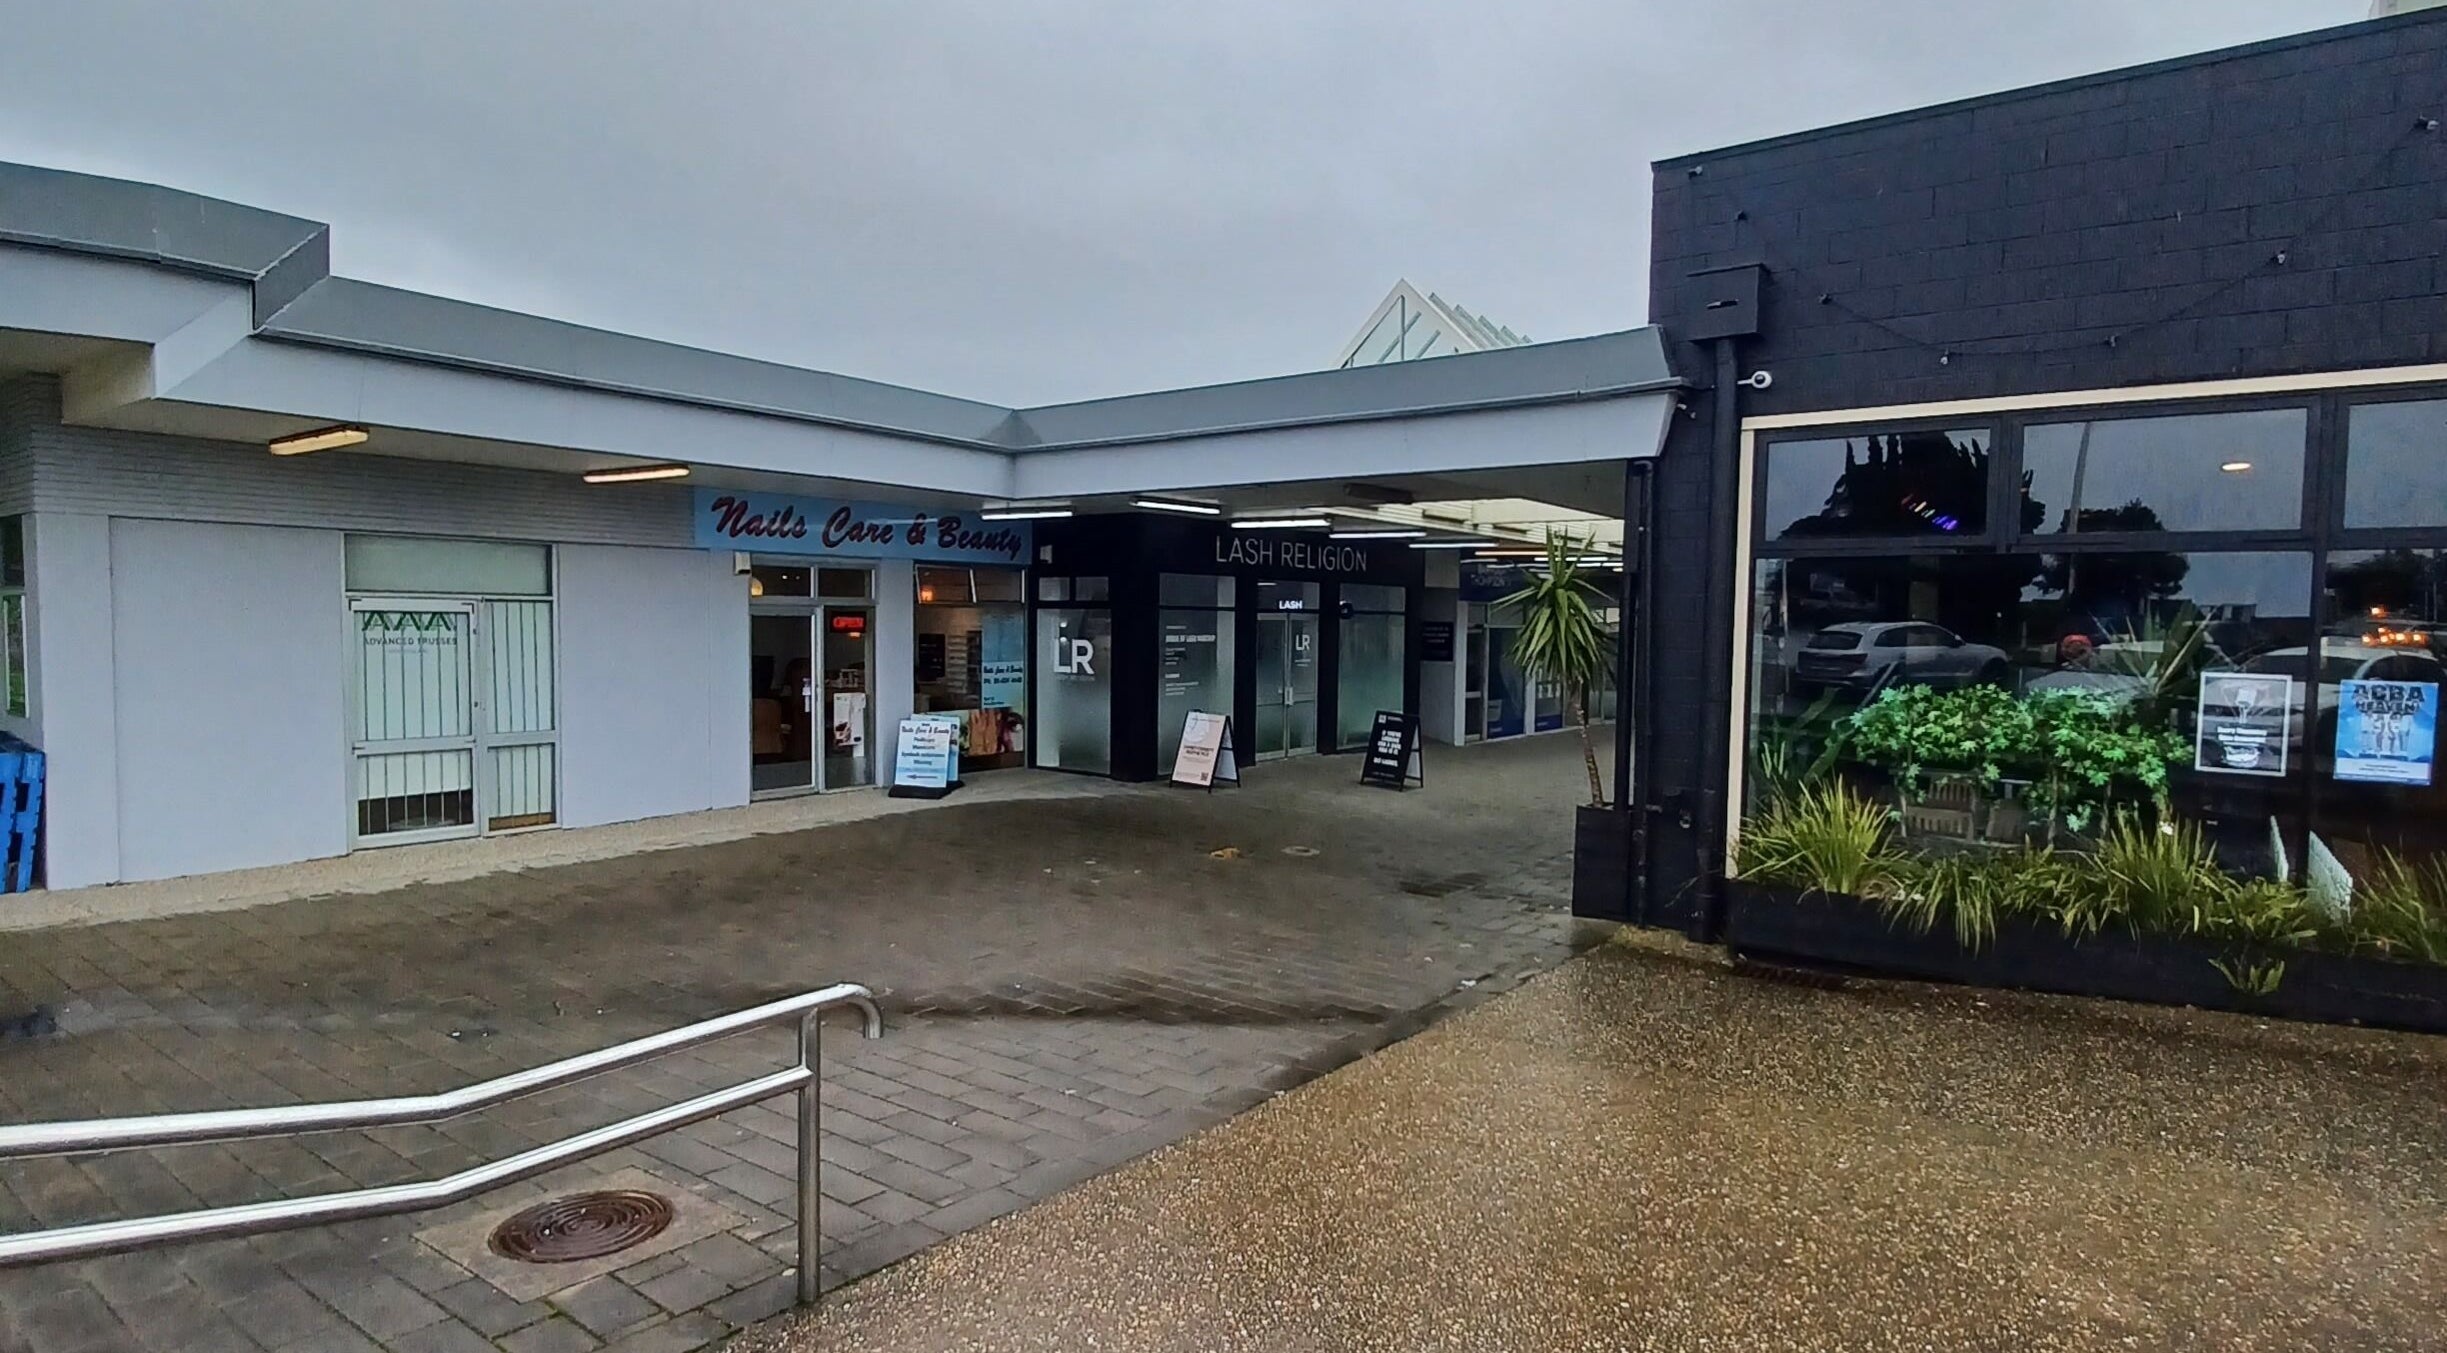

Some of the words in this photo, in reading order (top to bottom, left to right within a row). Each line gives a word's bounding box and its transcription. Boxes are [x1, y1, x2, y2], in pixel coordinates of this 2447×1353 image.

[711, 496, 807, 538] Nails
[822, 506, 893, 548] Care
[906, 512, 926, 545] &
[936, 515, 1022, 559] Beauty
[1216, 535, 1273, 566] LASH
[1281, 541, 1367, 572] RELIGION
[1279, 600, 1303, 610] LASH
[364, 637, 415, 645] ADVANCED
[1295, 634, 1310, 651] LR
[1053, 638, 1095, 675] LR
